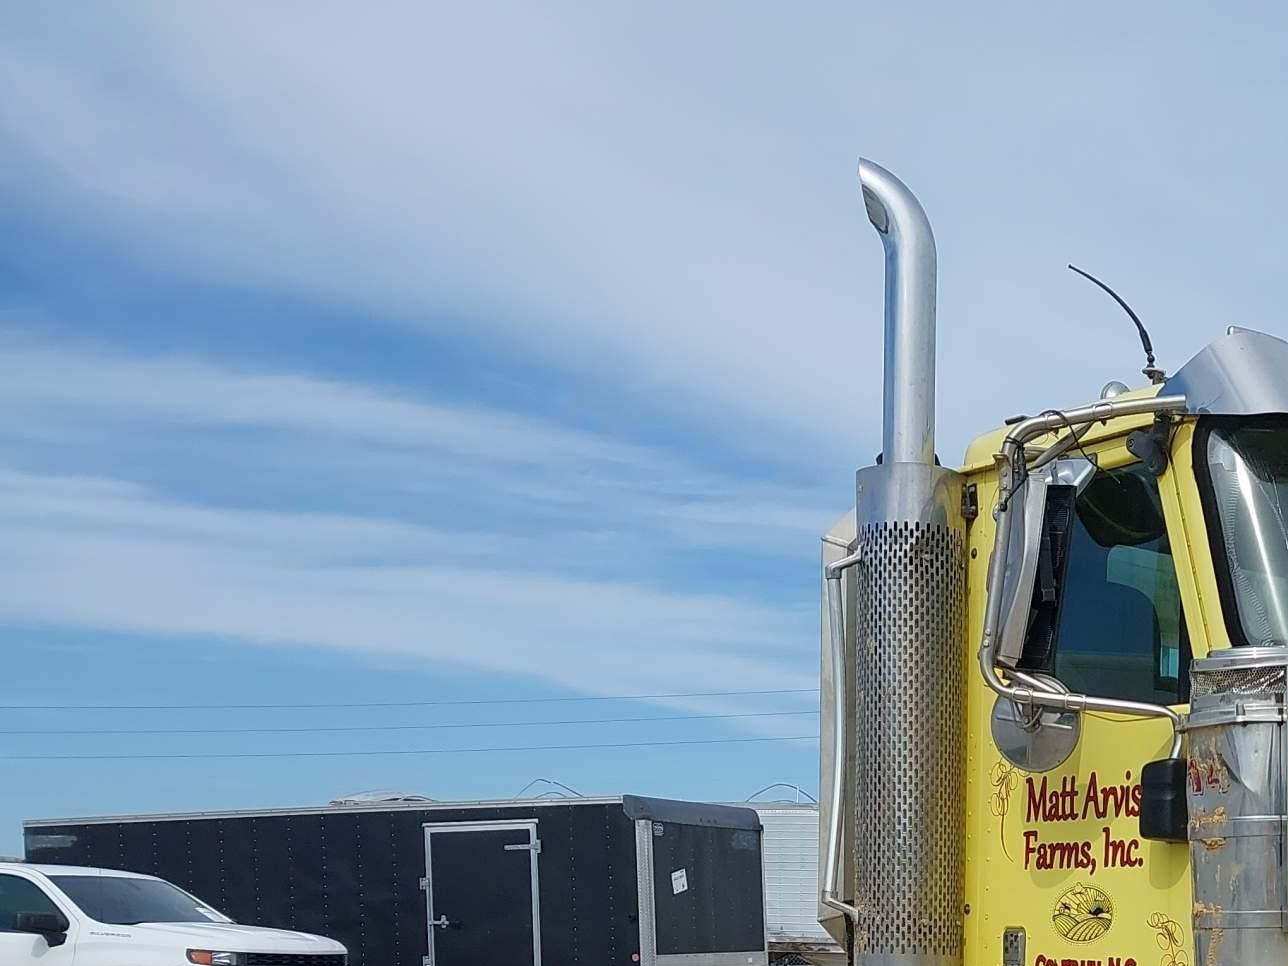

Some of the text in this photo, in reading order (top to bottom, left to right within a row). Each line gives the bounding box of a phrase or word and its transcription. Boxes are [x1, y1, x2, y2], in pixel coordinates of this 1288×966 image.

[1025, 770, 1142, 823] Matt Arvis
[1023, 827, 1144, 875] Farms, Inc.
